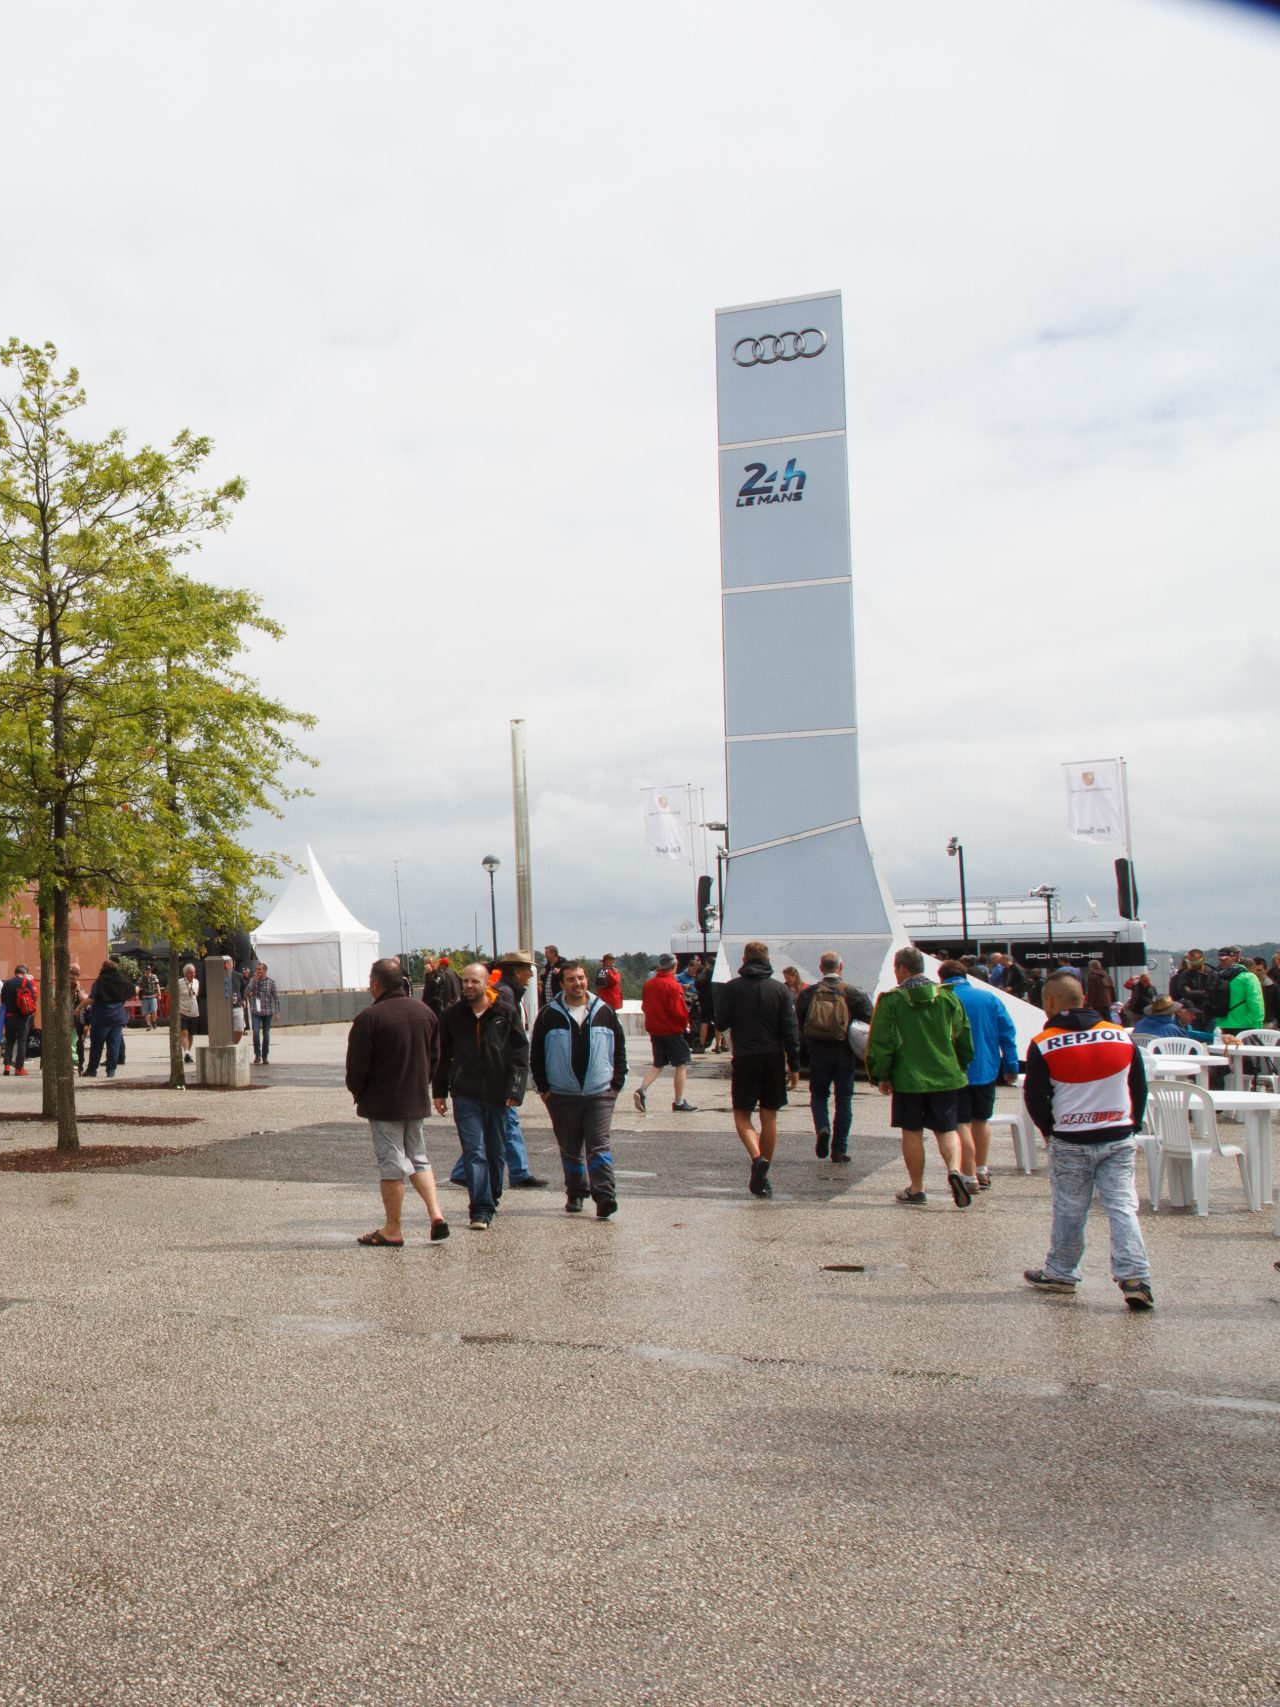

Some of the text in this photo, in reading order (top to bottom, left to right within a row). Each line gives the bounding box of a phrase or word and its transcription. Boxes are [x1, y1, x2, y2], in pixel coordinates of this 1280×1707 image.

[738, 457, 807, 497] 24h
[736, 491, 803, 507] LE MANS
[1047, 1030, 1125, 1050] REPSOL
